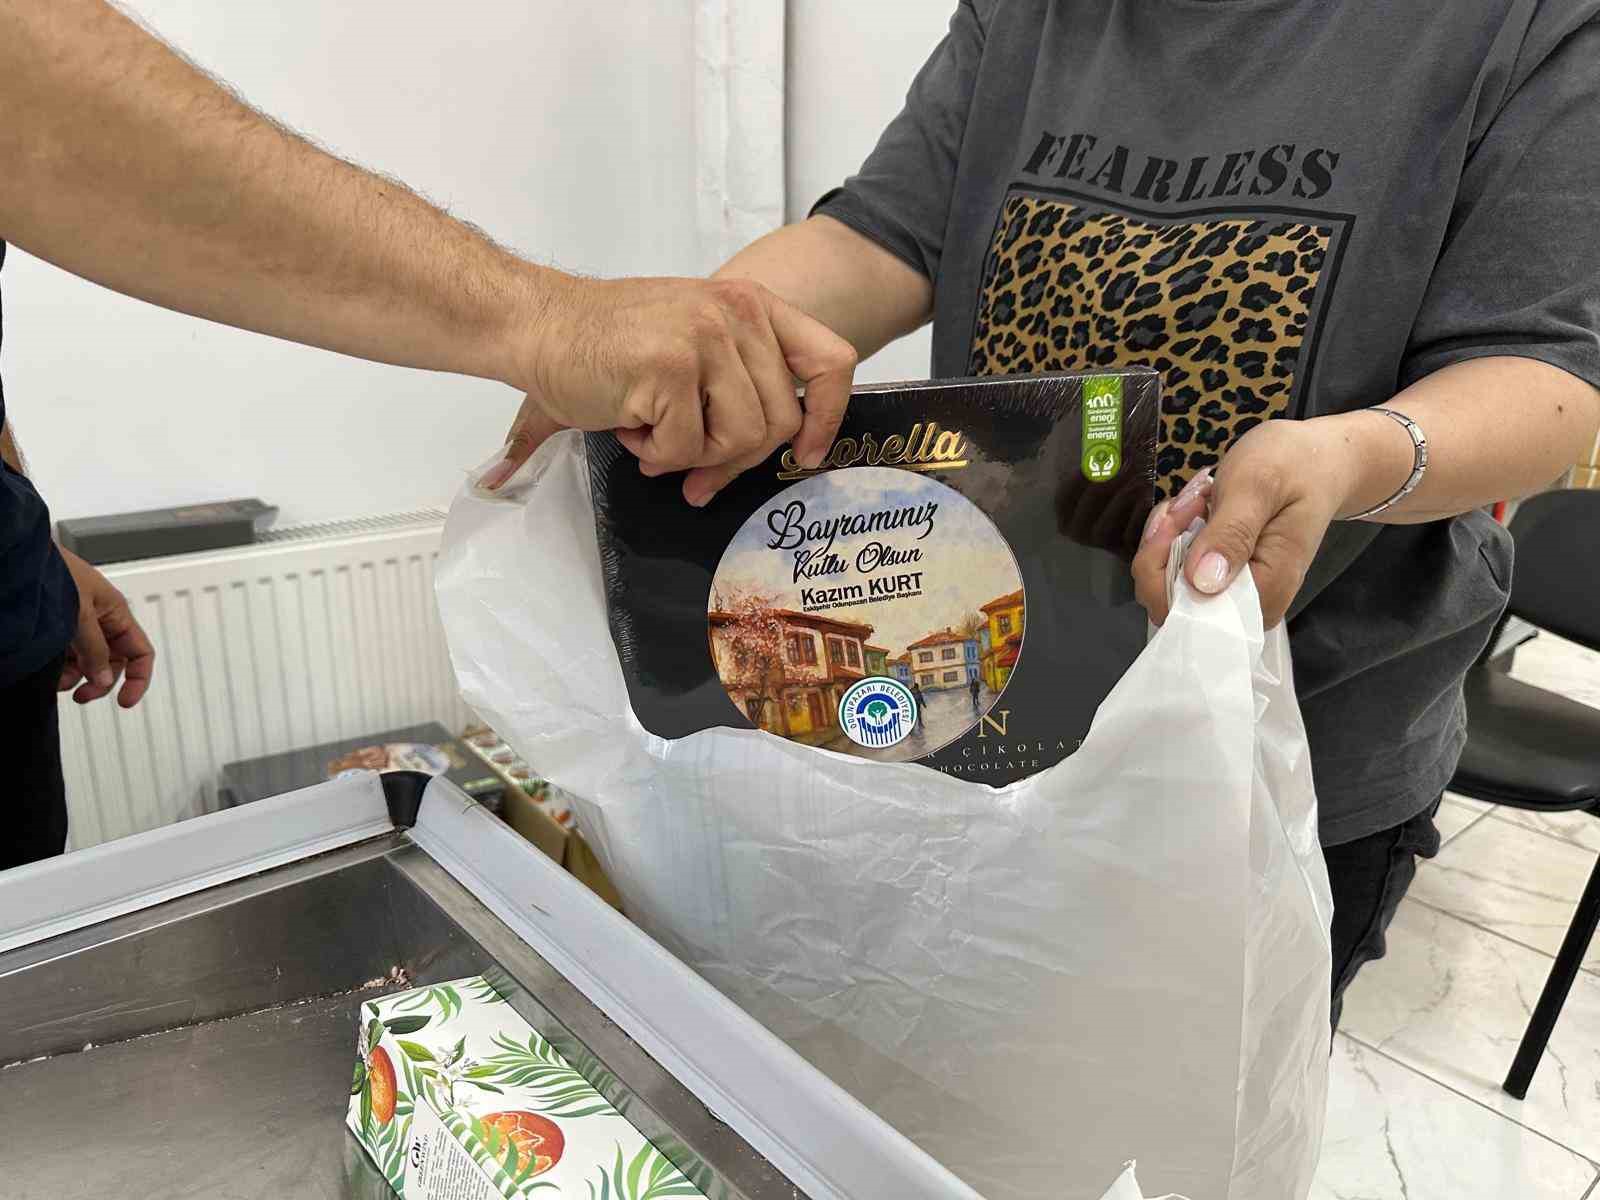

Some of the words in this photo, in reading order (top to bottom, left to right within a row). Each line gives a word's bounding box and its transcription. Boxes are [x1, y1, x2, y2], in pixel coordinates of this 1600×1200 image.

[1022, 131, 1341, 202] FEARLESS
[781, 422, 967, 472] orella
[767, 500, 938, 555] Bayramınız
[793, 549, 849, 584] Kutlu
[856, 542, 923, 573] Olsun
[801, 587, 863, 606] Kazım
[868, 572, 923, 596] KURT
[846, 684, 876, 729] ODUNPAZARI
[939, 759, 1041, 773] HOCOLATE
